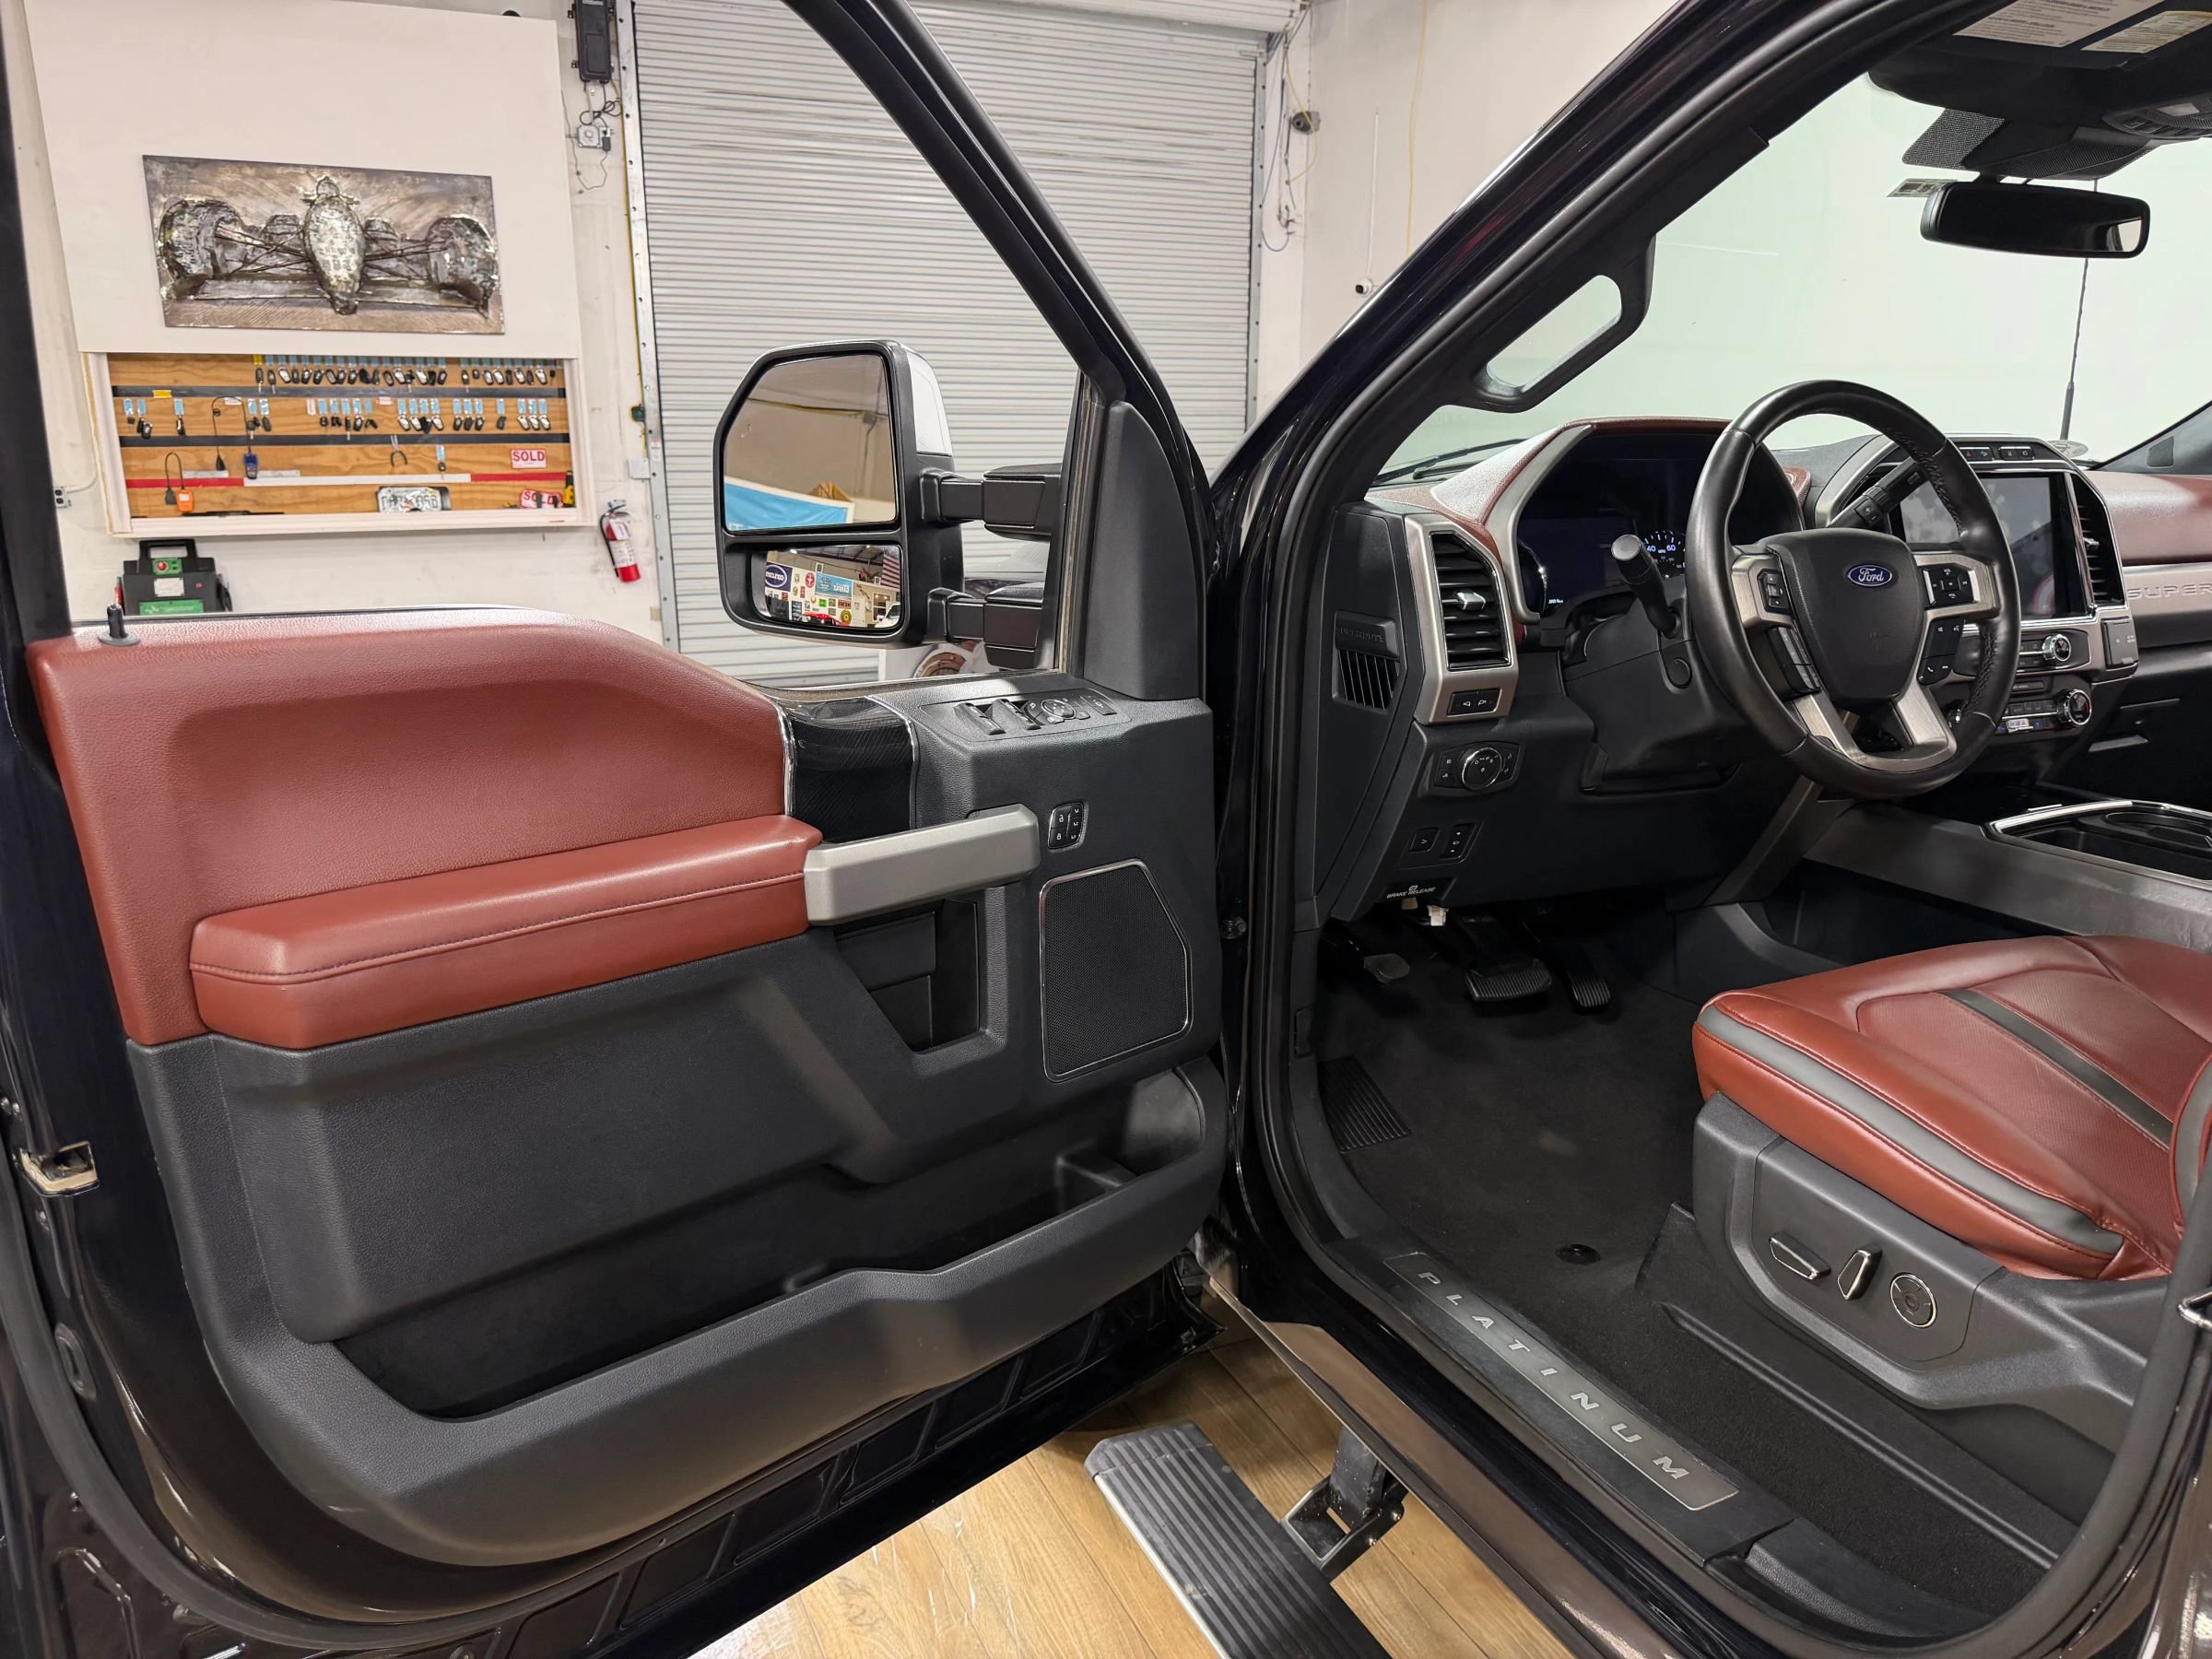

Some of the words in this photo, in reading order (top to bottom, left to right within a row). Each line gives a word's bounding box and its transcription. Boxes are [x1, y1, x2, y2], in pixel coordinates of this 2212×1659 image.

[512, 450, 546, 462] SOLD
[1858, 567, 1885, 582] Ford
[2127, 582, 2212, 601] SUPER
[1386, 890, 1408, 899] BRAKE
[1408, 887, 1436, 896] RELEASE
[1418, 1271, 1690, 1480] PLATINUM
